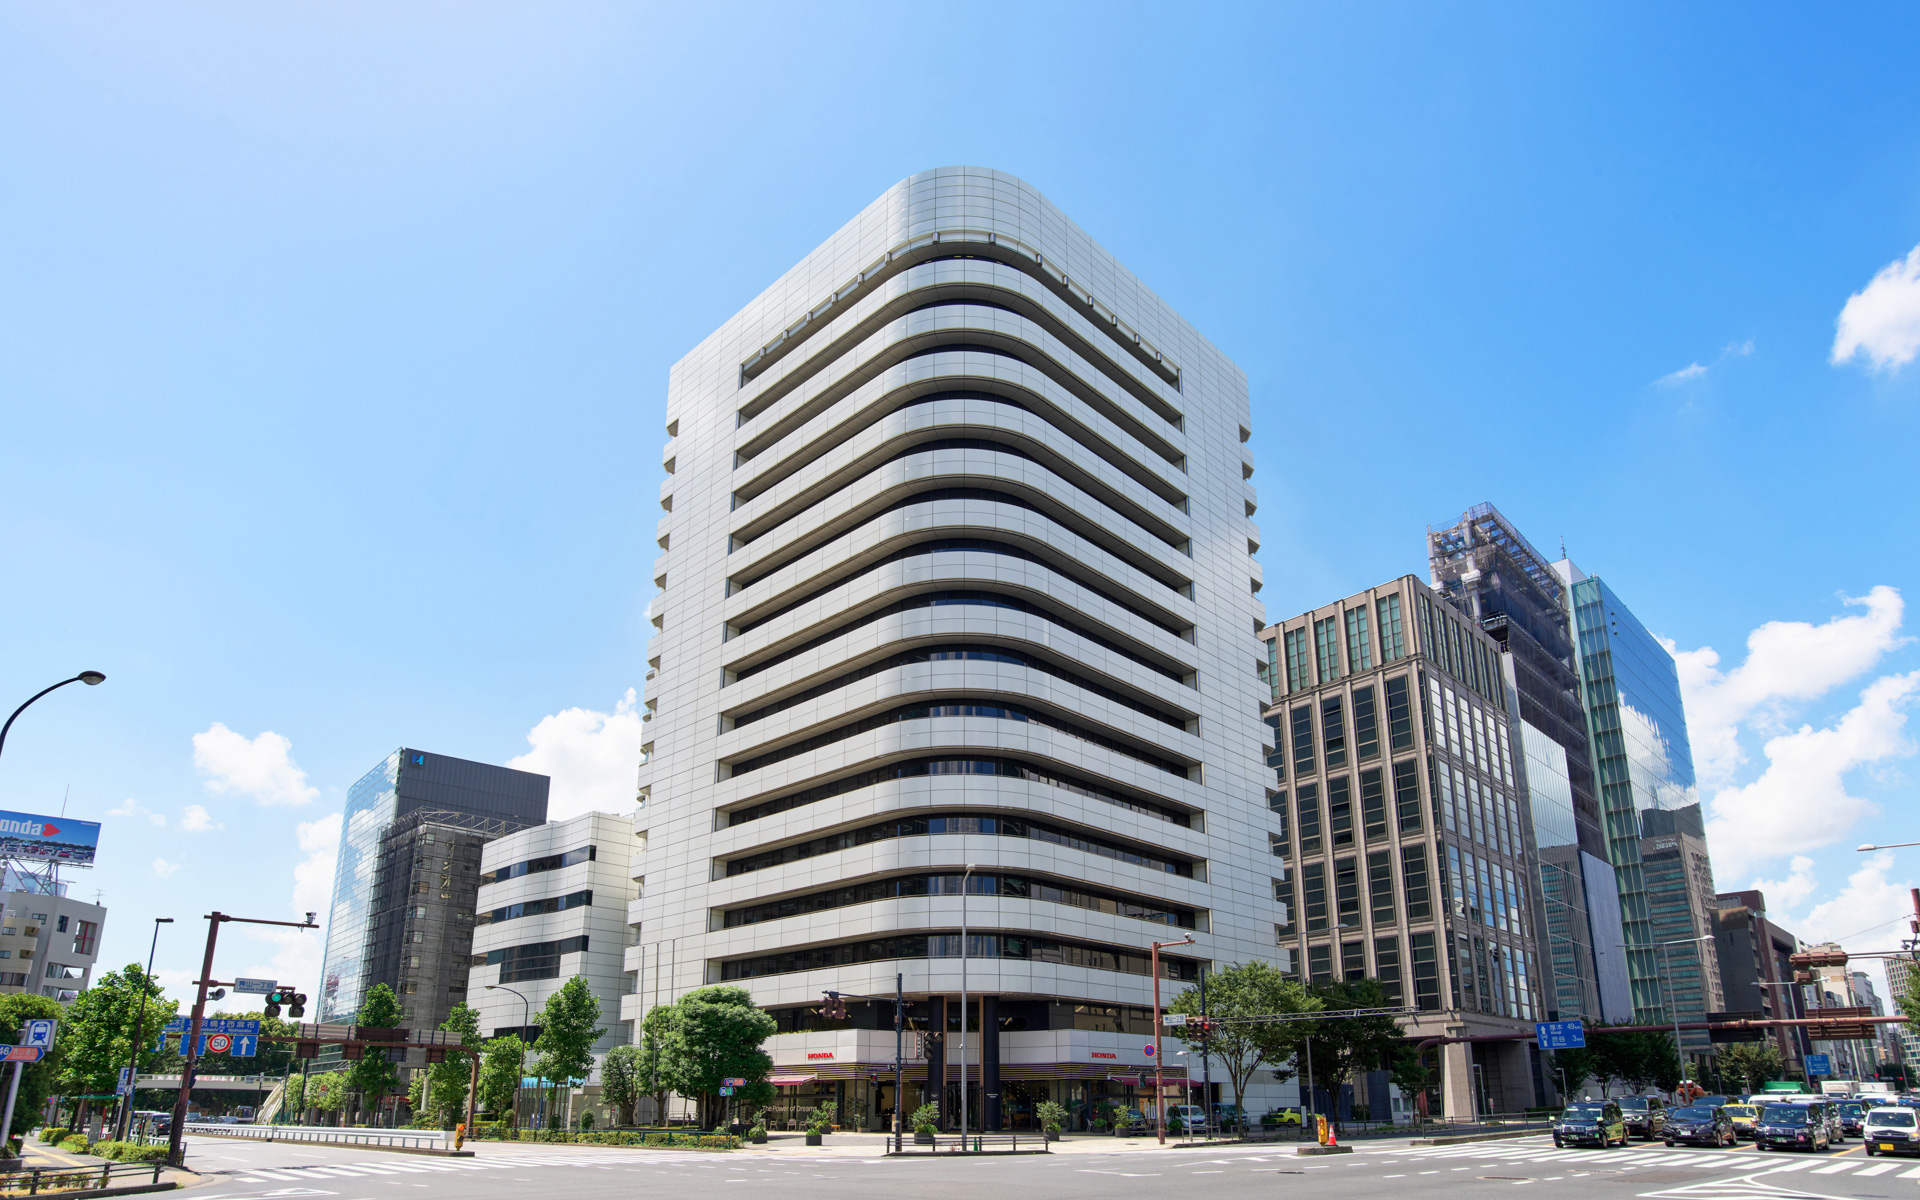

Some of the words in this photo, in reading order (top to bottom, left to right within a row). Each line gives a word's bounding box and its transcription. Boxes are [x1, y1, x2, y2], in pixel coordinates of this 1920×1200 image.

[0, 819, 42, 836] onda
[239, 981, 274, 989] 青山一丁目
[226, 1020, 256, 1029] 西麻布
[214, 1039, 226, 1047] 50
